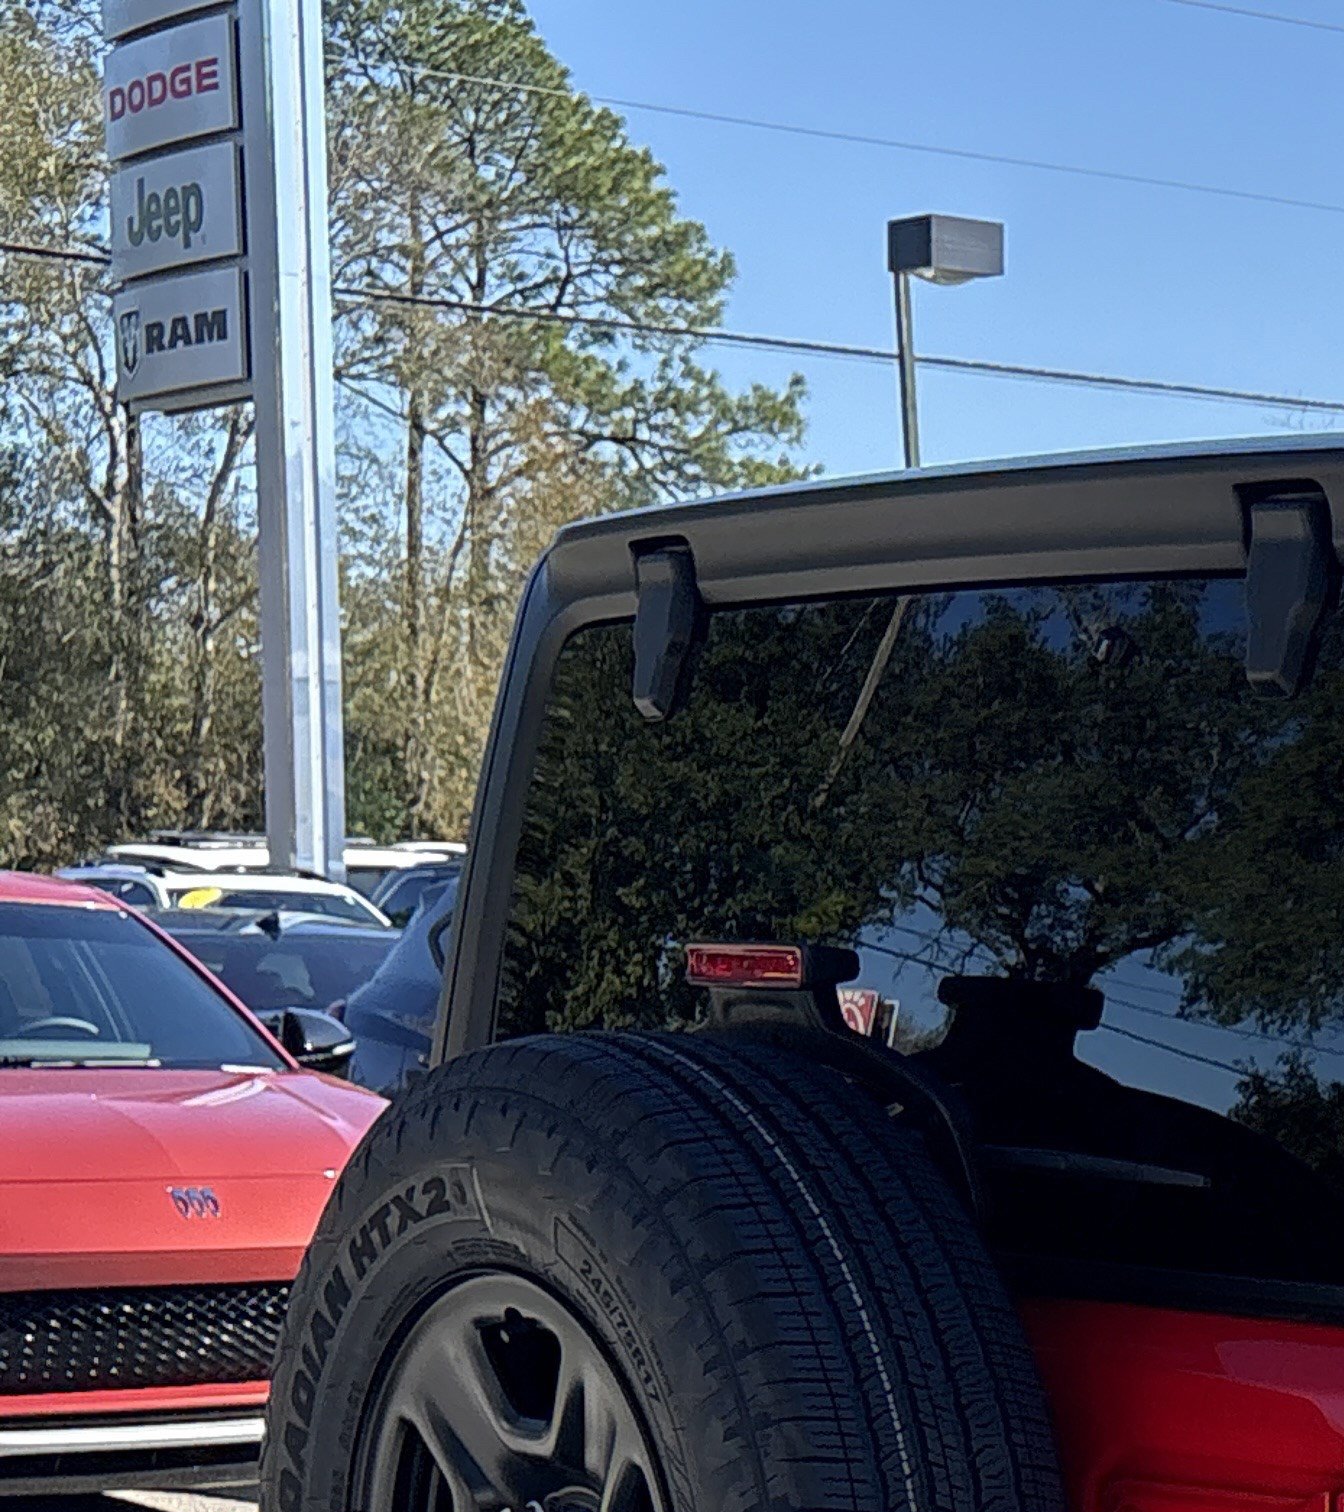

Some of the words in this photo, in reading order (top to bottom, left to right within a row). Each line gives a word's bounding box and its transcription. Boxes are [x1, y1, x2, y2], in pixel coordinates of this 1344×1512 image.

[110, 58, 219, 122] DODGE
[128, 178, 204, 248] Jeep
[145, 308, 228, 356] RAM
[348, 1175, 451, 1278] HTX2
